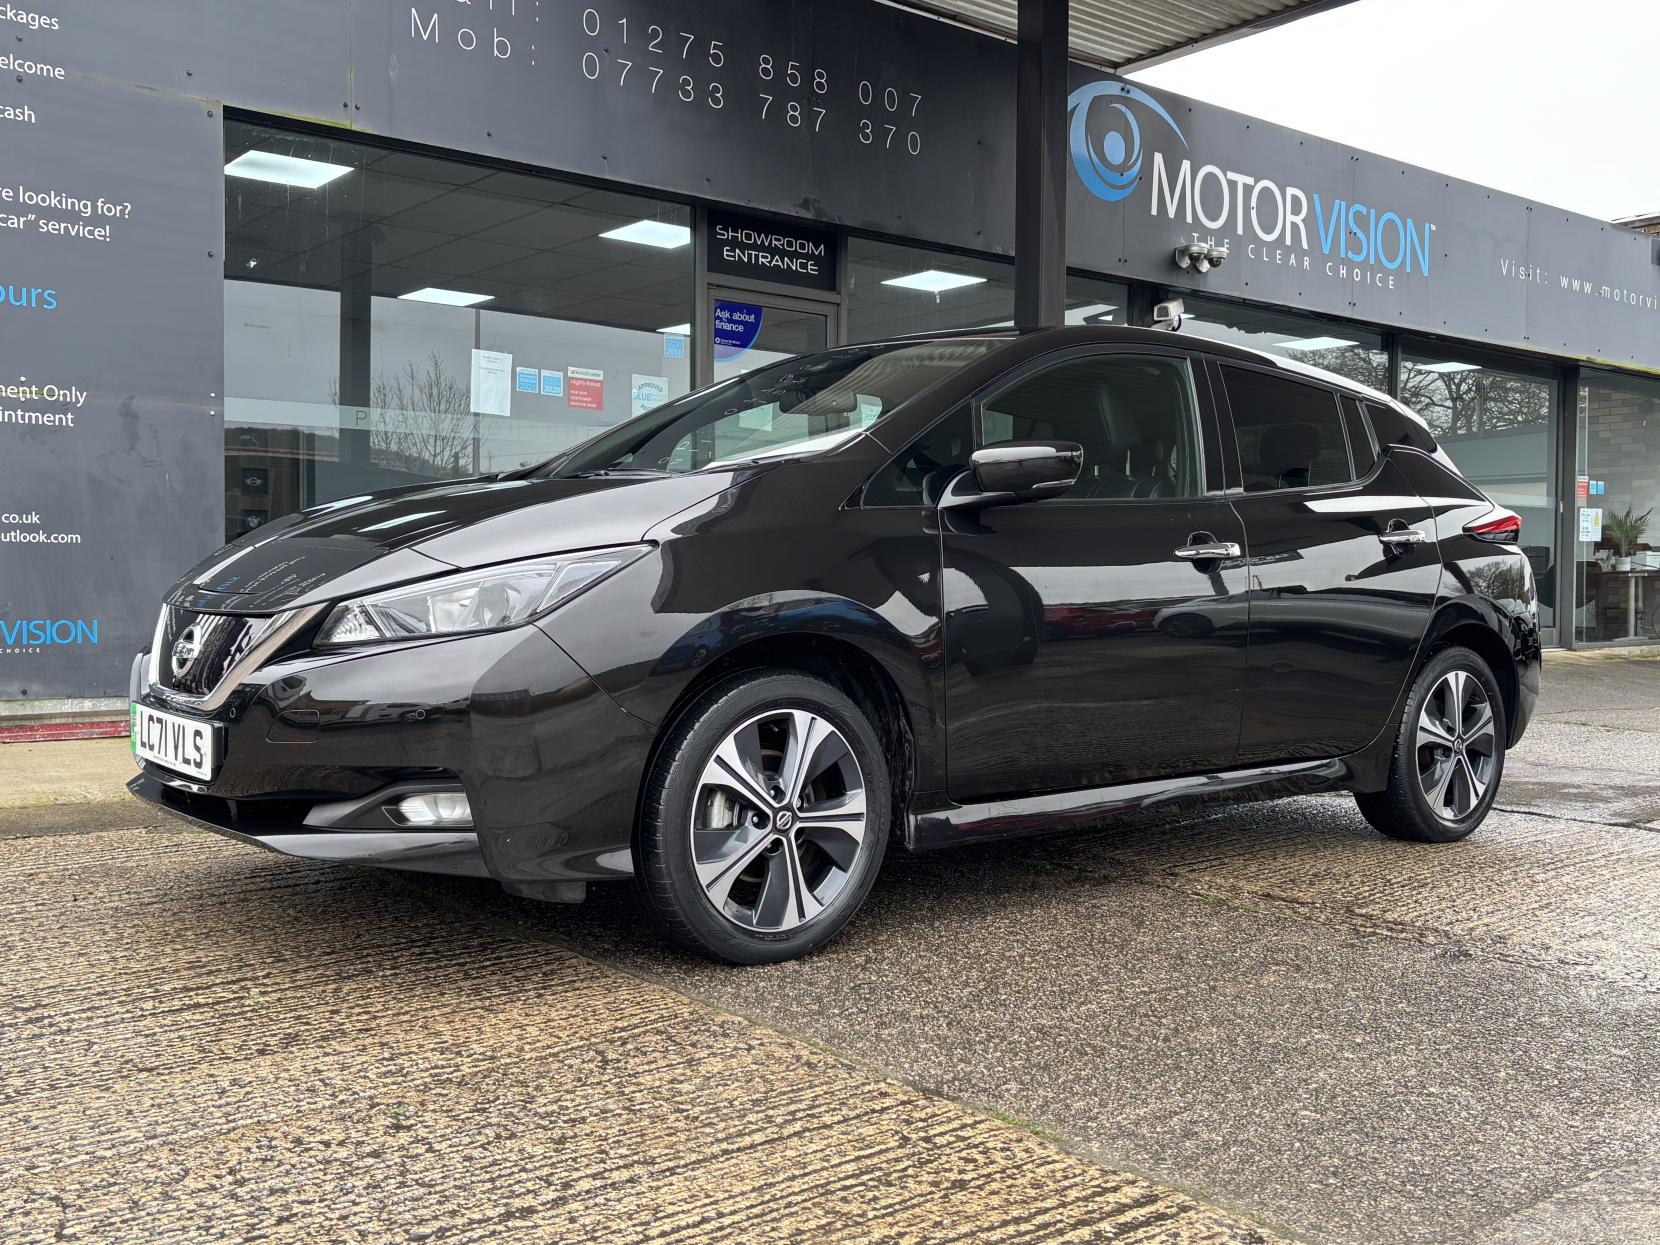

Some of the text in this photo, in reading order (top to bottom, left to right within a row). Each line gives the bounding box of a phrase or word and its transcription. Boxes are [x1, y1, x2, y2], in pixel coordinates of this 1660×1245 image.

[411, 8, 536, 66] Mob:
[583, 9, 724, 67] 01275
[759, 54, 827, 93] 858
[859, 81, 922, 117] 007
[582, 52, 921, 155] 07733 787 370
[19, 185, 92, 217] looking
[96, 198, 132, 219] for?
[39, 218, 111, 242] service!
[716, 225, 825, 257] SHOWROOM
[723, 246, 819, 275] ENTRANCE
[1192, 232, 1395, 289] THE CLEAR CHOICE
[1500, 258, 1549, 285] Visit:
[0, 285, 57, 309] urs
[715, 308, 756, 322] Ask about
[715, 319, 745, 332] finance
[43, 385, 87, 407] Only
[140, 710, 204, 770] LC71 VLS
